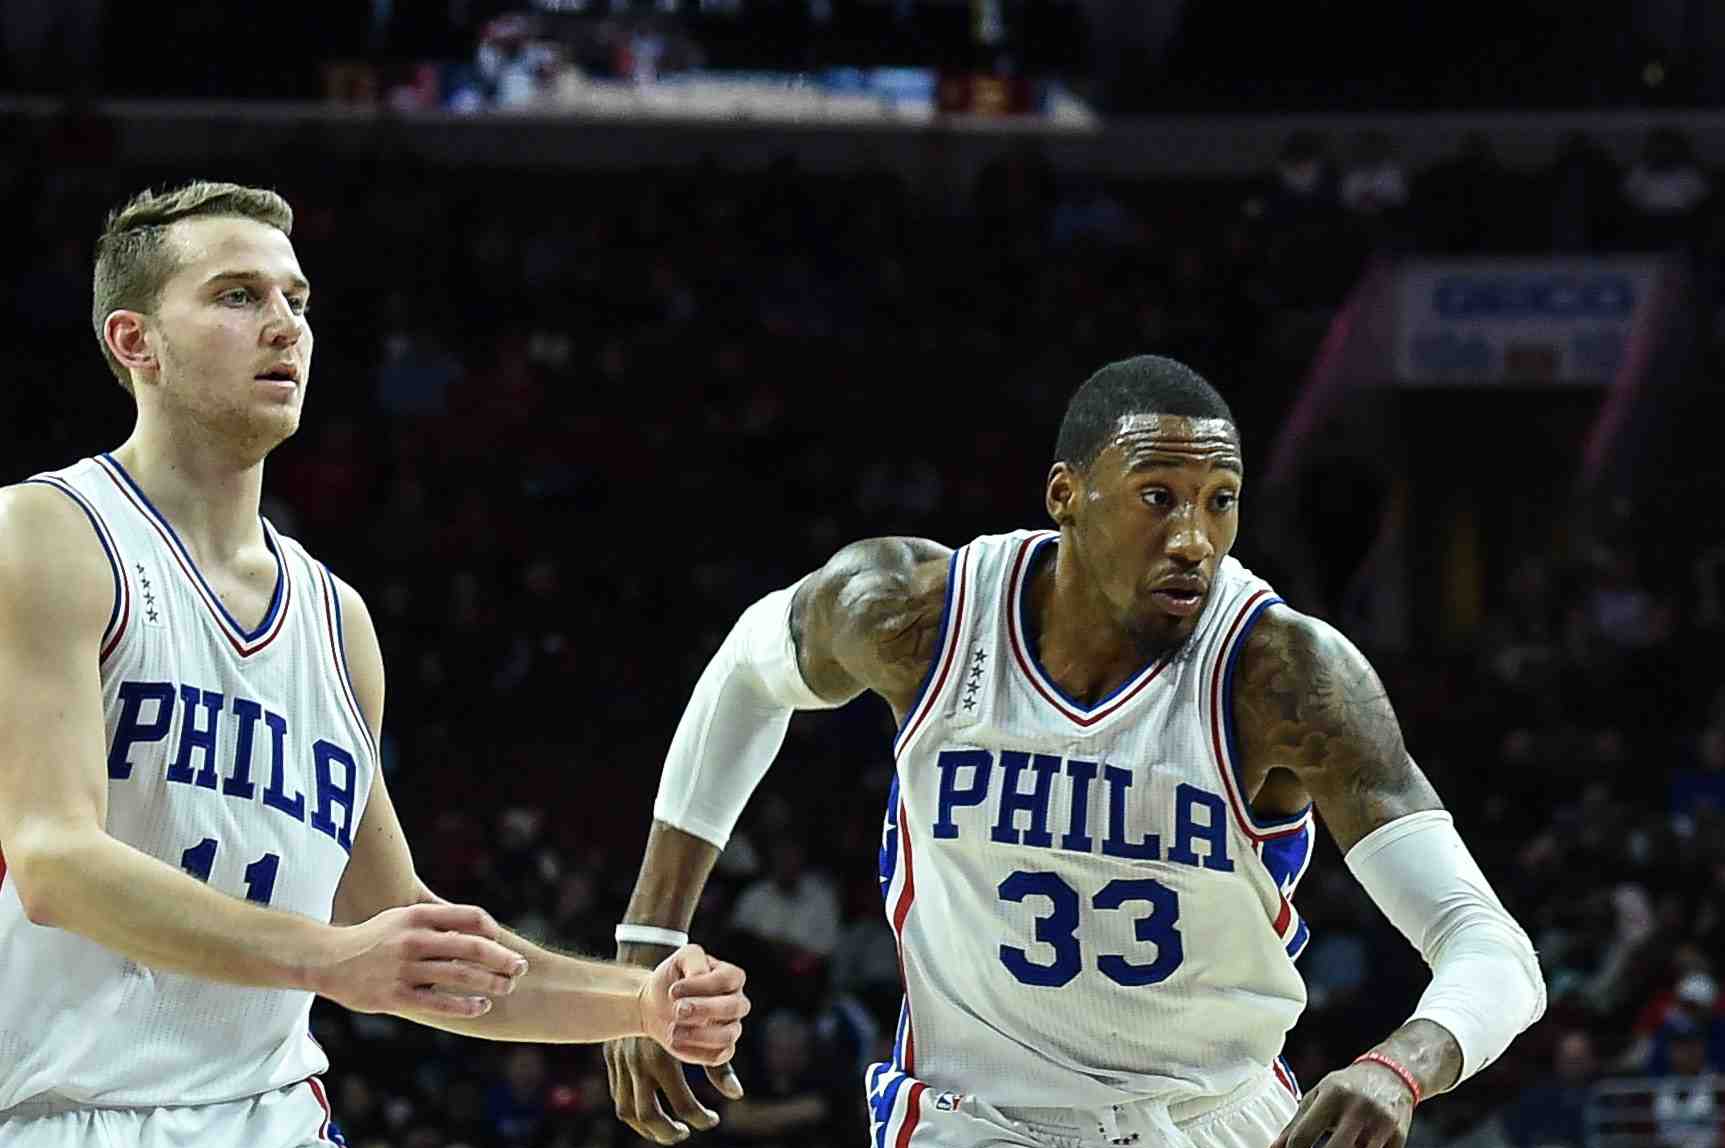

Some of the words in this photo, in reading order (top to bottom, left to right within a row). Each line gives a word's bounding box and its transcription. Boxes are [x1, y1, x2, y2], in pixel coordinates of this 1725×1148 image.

[108, 681, 356, 854] PHILA
[933, 749, 1234, 872] PHILA
[998, 871, 1183, 987] 33
